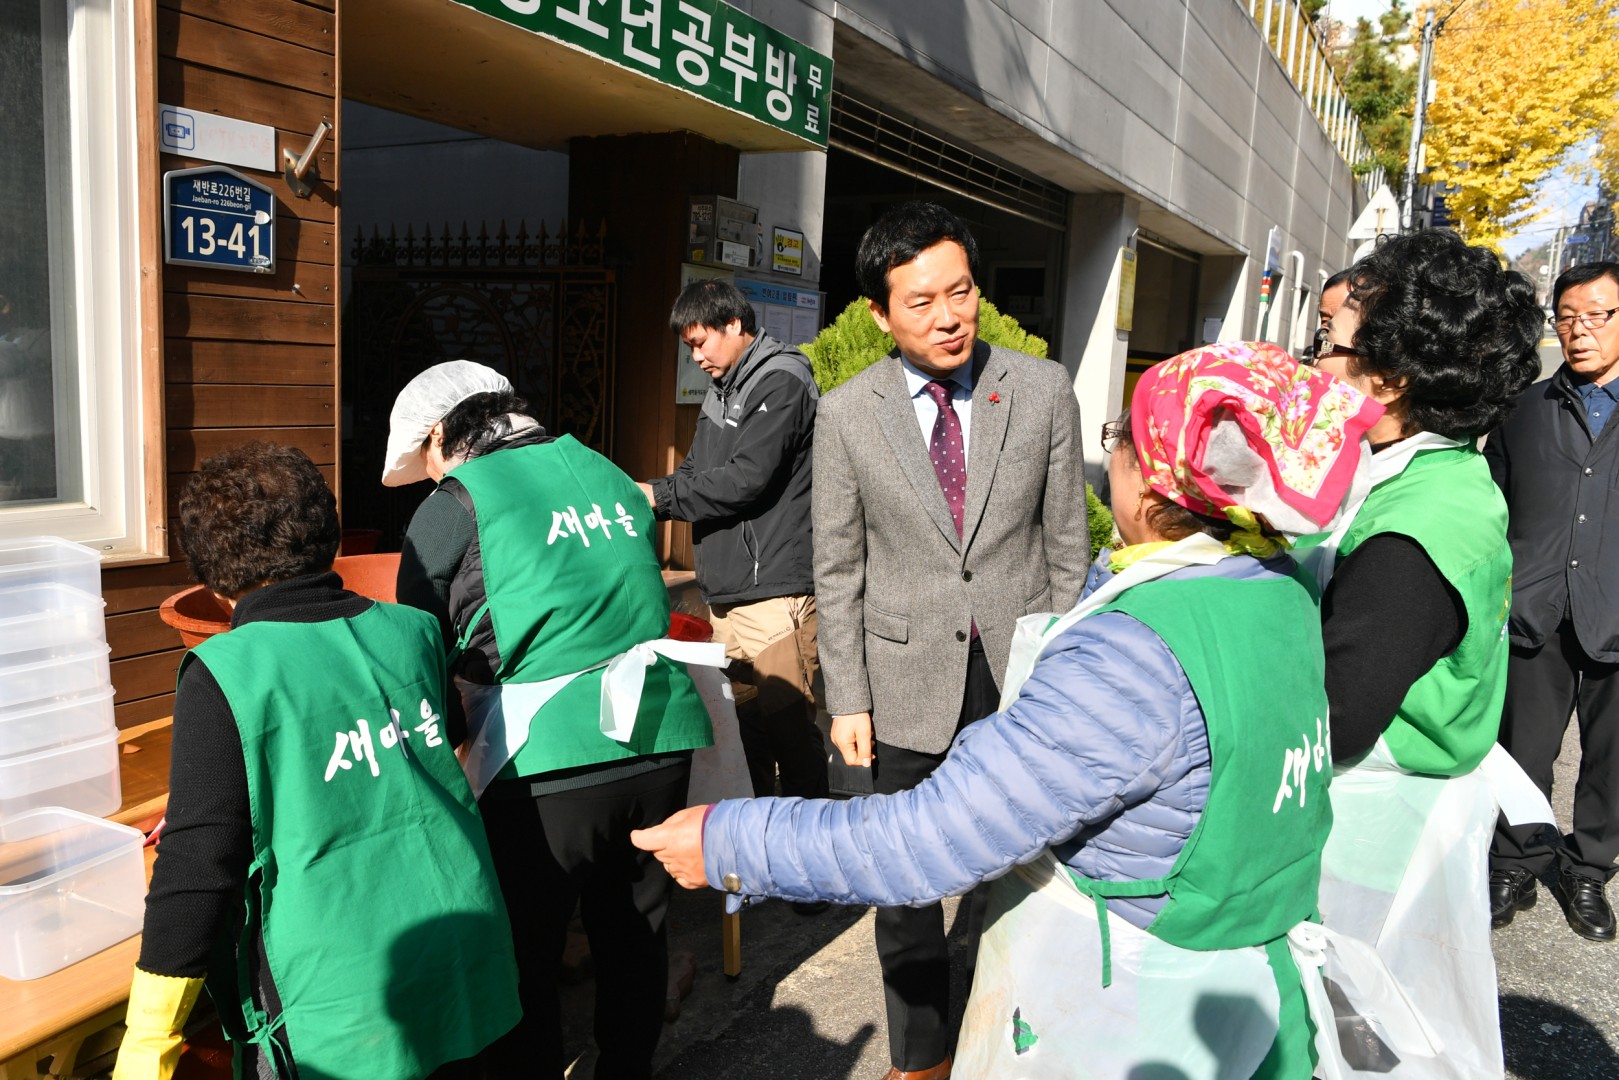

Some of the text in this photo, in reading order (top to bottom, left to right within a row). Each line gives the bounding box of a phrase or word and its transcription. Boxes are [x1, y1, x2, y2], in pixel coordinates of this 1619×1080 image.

[498, 0, 798, 122] 년공부방
[192, 179, 251, 202] 재반로226번길
[192, 195, 252, 211] Jaeban-ro 226beon-gil
[181, 216, 261, 259] 13-41
[546, 501, 638, 547] 새마을
[324, 698, 444, 783] 새마을
